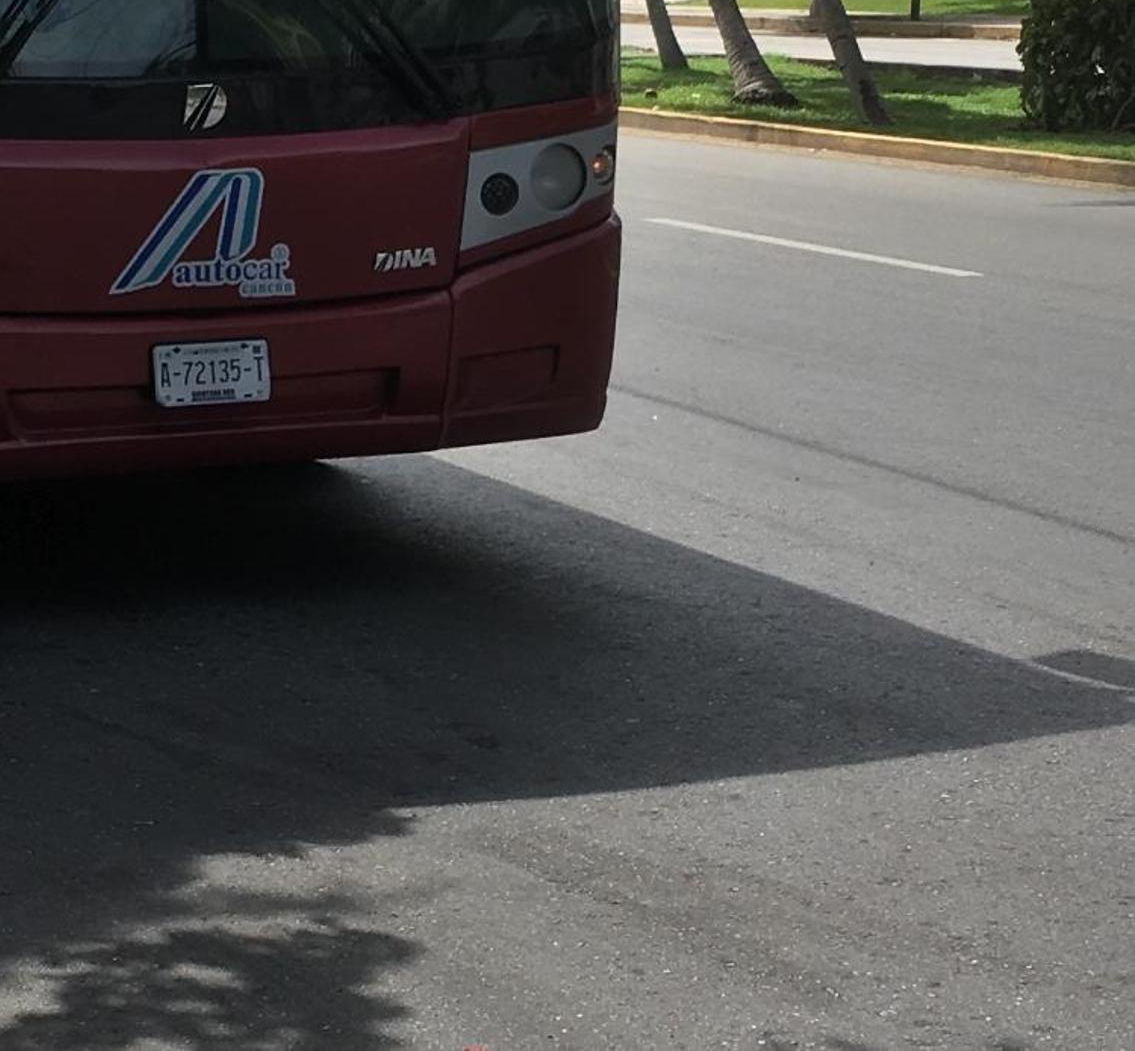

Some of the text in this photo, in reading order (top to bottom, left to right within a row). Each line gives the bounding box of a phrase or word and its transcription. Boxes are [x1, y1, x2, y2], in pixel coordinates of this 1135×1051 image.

[176, 258, 287, 283] autocar
[374, 247, 437, 271] DINA
[161, 356, 264, 388] A-72135-T
